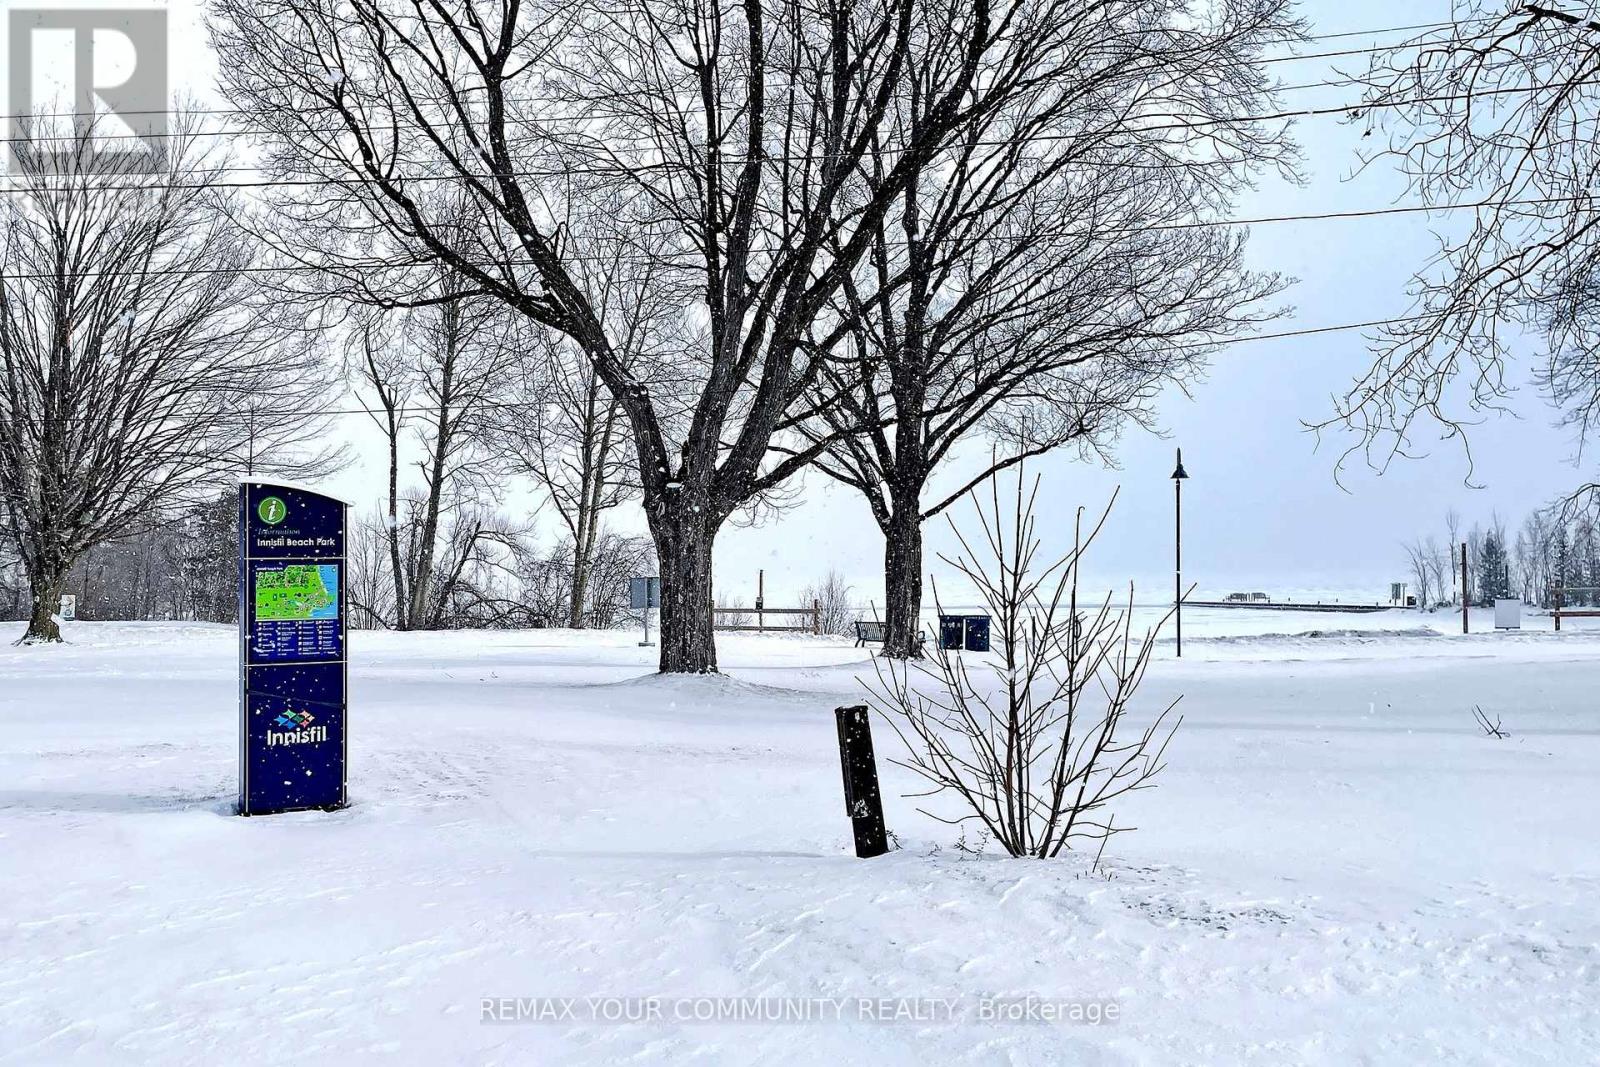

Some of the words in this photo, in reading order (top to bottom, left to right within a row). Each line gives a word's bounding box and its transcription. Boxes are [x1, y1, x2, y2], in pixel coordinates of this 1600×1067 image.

[287, 538, 314, 547] Beach
[317, 537, 336, 547] Park
[267, 726, 327, 746] Innisfil
